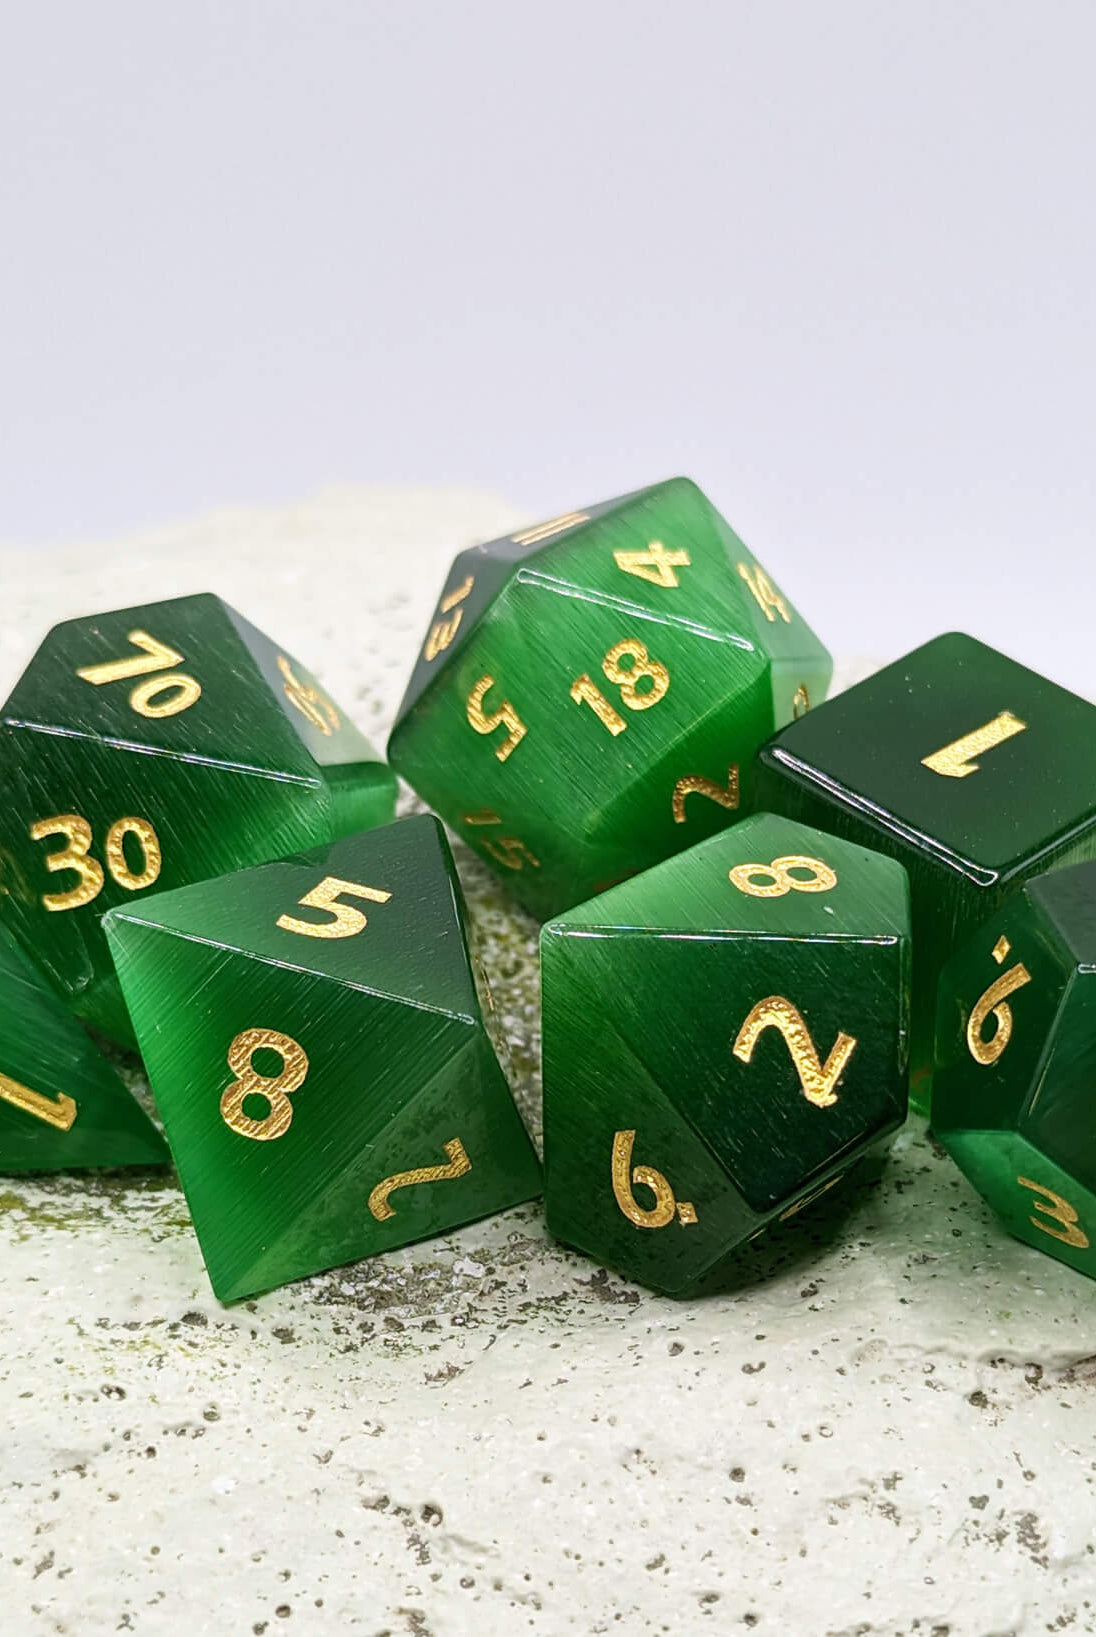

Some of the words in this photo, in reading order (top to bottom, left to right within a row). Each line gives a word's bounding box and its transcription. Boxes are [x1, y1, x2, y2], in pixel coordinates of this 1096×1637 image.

[613, 541, 692, 588] 4
[466, 674, 528, 763] 5
[570, 638, 670, 736] 18
[921, 711, 1027, 778] 1
[30, 814, 161, 912] 30
[728, 855, 838, 898] 8
[276, 876, 392, 939] 5
[219, 1027, 310, 1141] 8
[732, 995, 858, 1108] 2
[1017, 1176, 1090, 1249] 3
